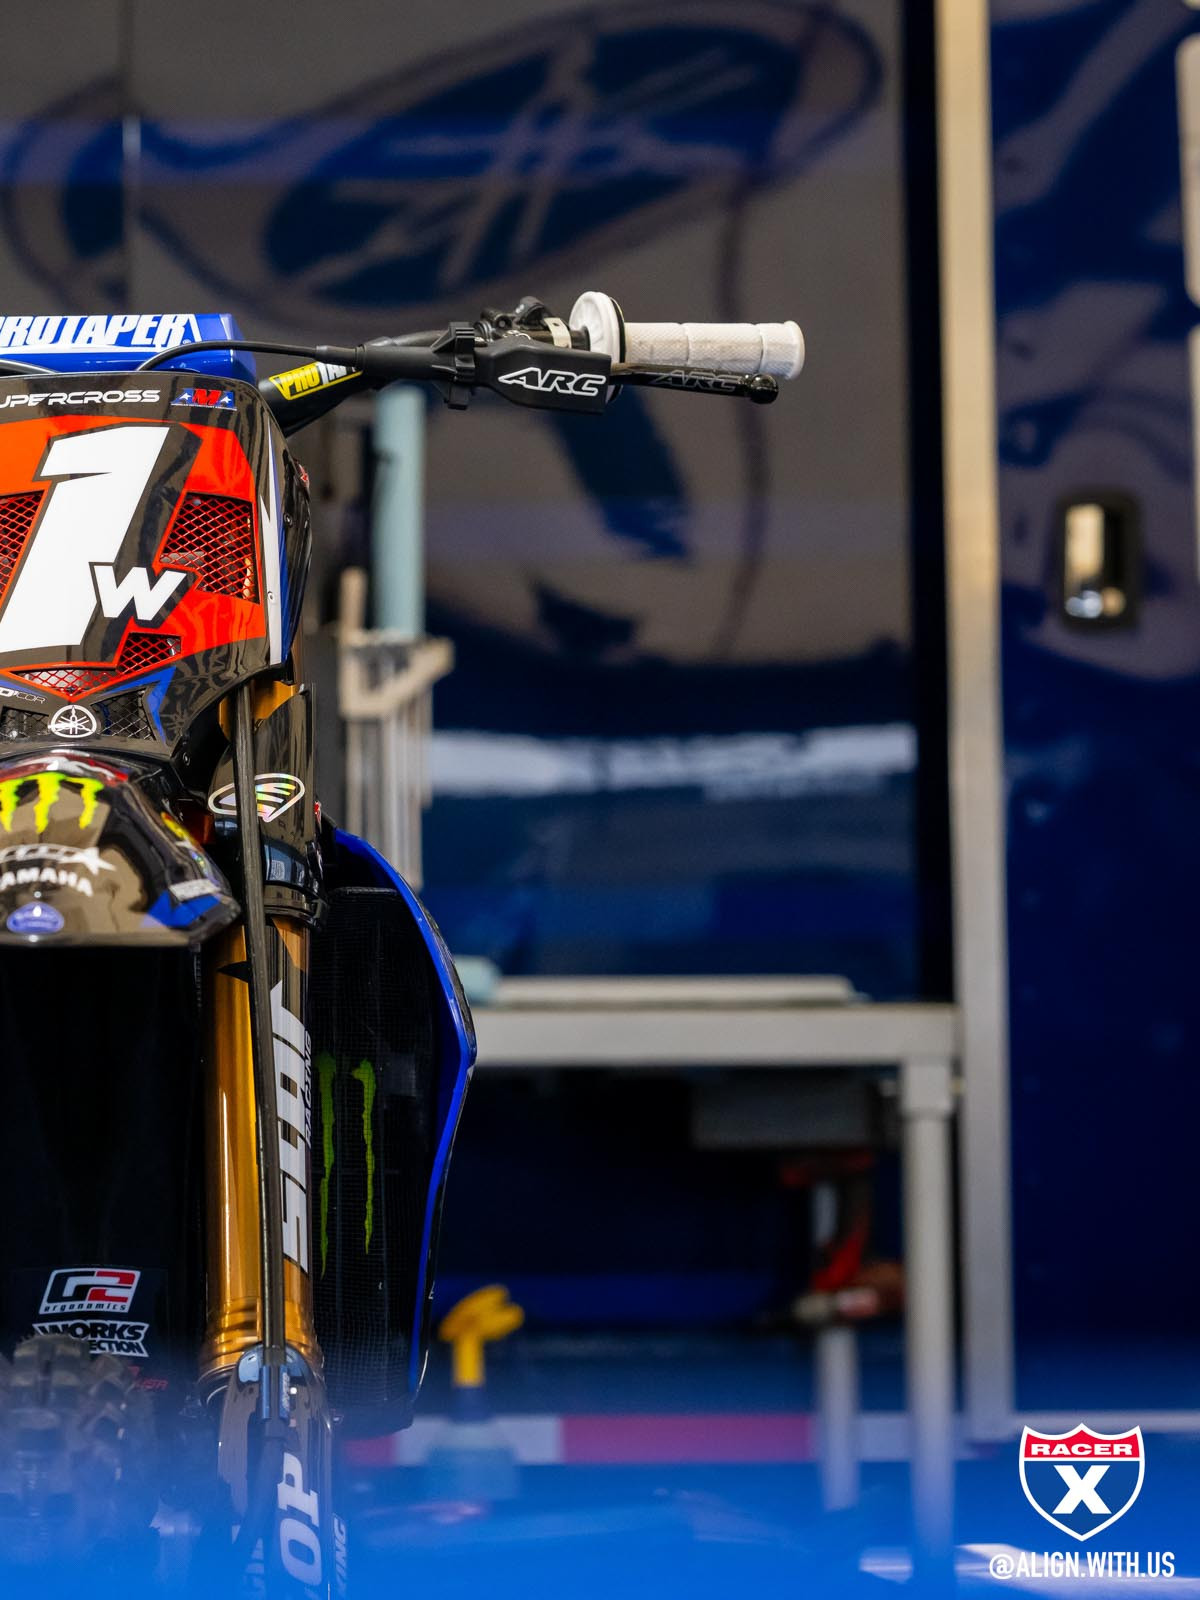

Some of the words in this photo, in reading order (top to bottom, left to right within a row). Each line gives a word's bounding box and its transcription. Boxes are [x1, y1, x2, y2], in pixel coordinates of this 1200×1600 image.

[498, 366, 606, 397] ARC
[649, 369, 744, 393] ARC
[171, 388, 234, 408] AMA
[37, 1322, 145, 1342] WORKS
[89, 1340, 144, 1355] ECTION
